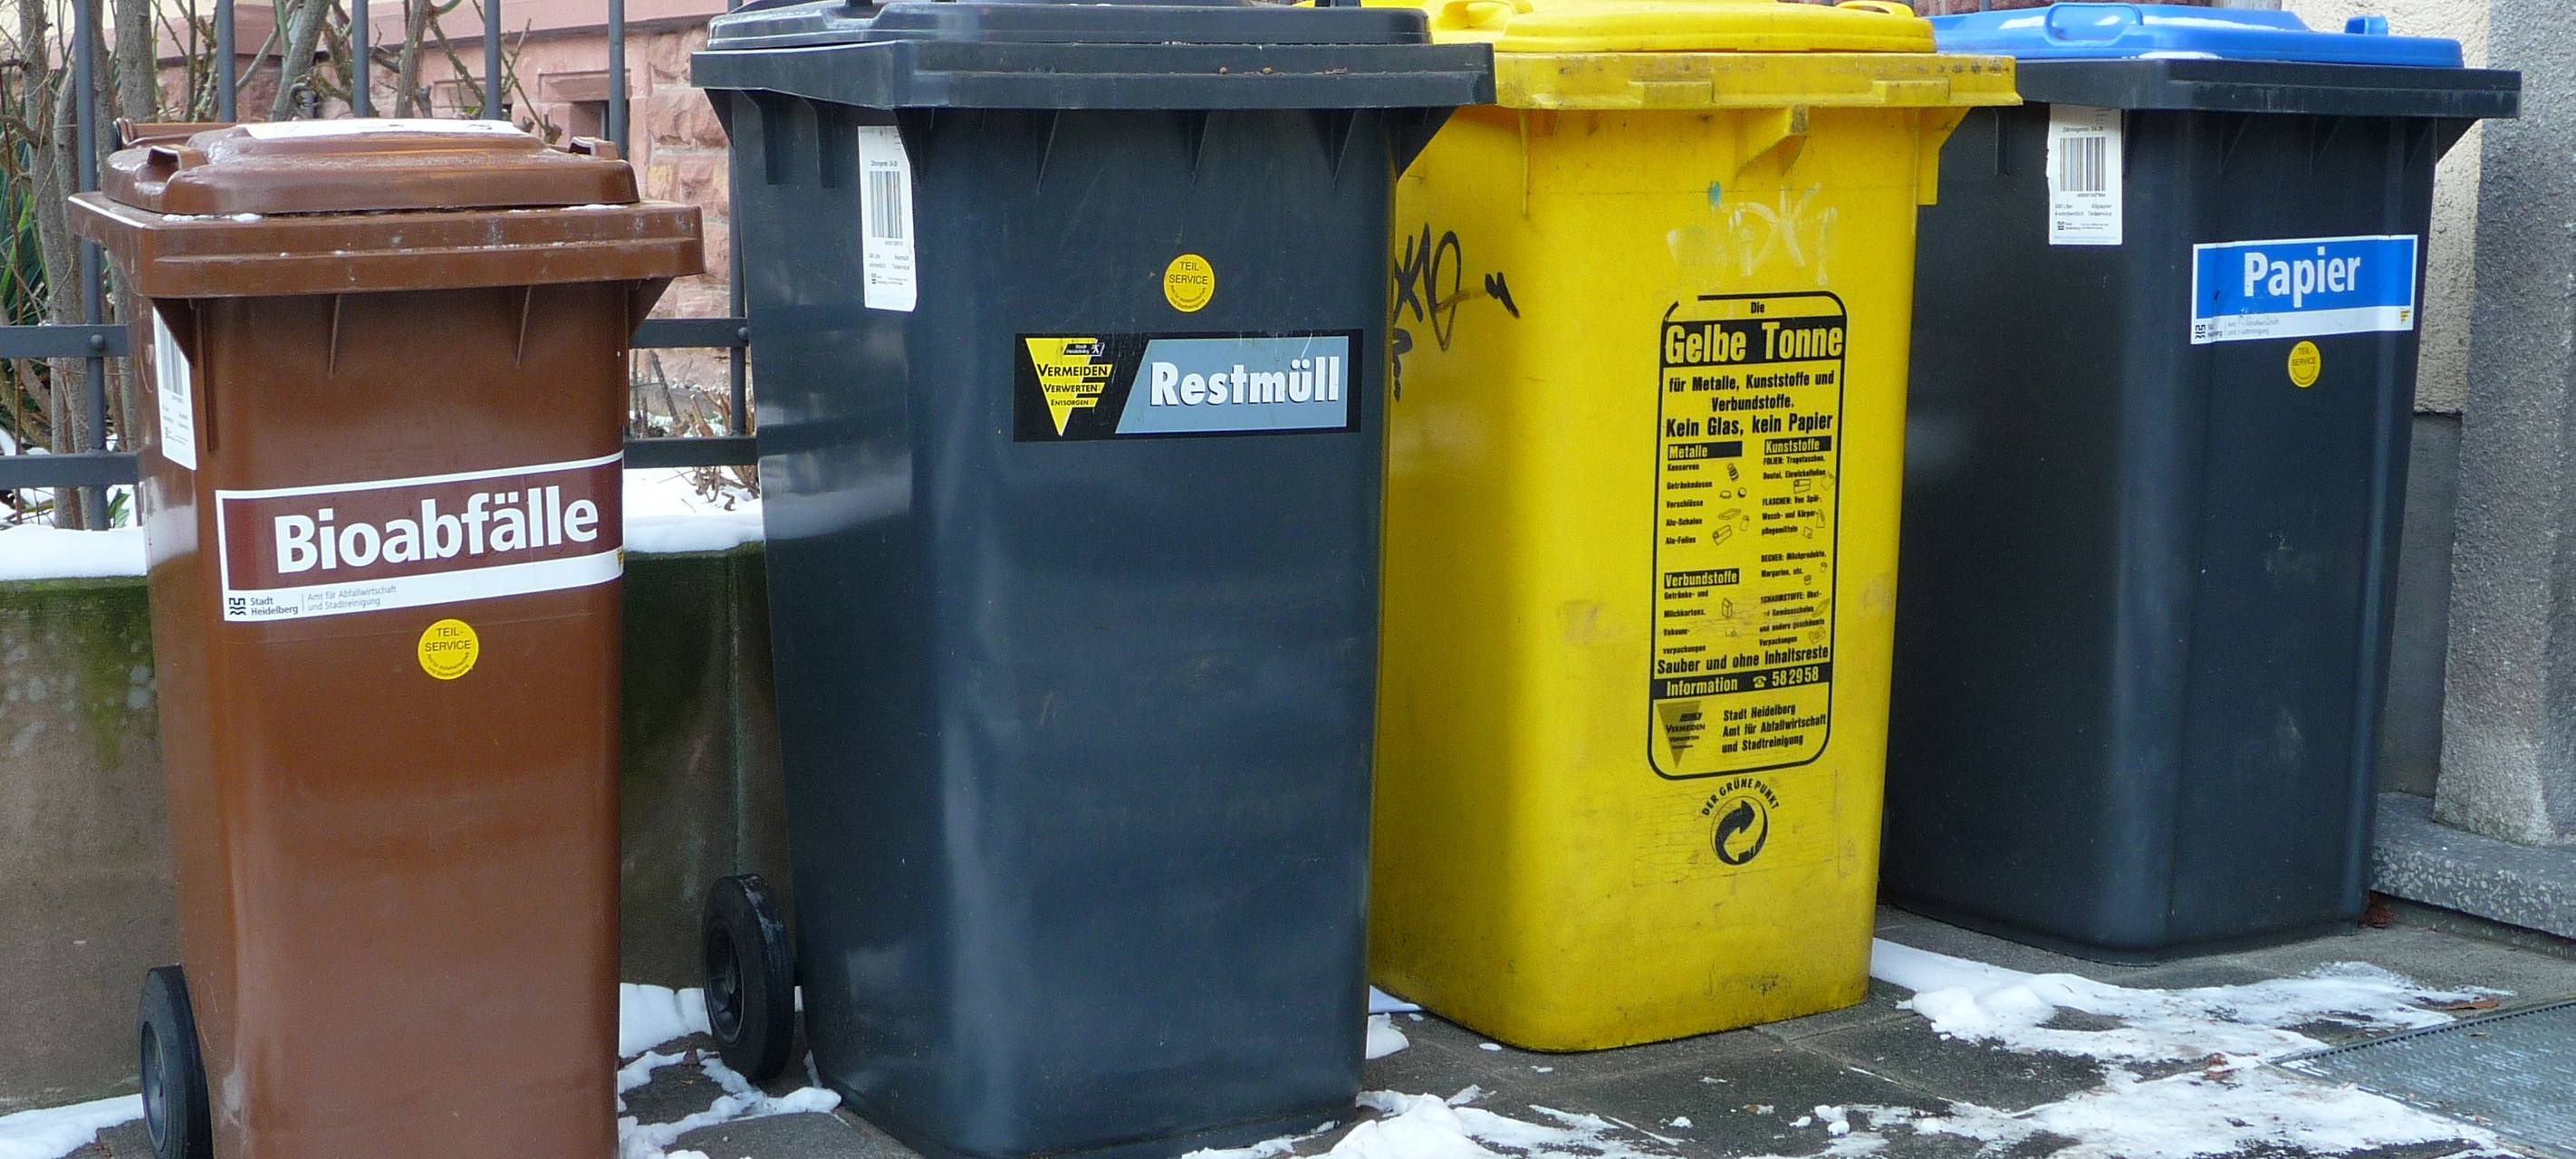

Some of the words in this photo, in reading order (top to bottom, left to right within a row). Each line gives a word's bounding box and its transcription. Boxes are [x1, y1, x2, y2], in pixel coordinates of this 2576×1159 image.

[1179, 261, 1203, 271] TEIL-
[1168, 274, 1208, 285] SERVICE
[2244, 245, 2361, 308] Papier
[1751, 302, 1765, 313] Die
[1665, 323, 1746, 364] Gelbe
[1761, 321, 1842, 360] Tonne
[1037, 363, 1108, 377] VERMEIDEN
[1149, 356, 1340, 407] Restmüll
[1669, 378, 1687, 392] für
[1692, 375, 1739, 391] Metalle,
[1745, 371, 1810, 389] Kunststoffe
[1815, 370, 1834, 385] und
[1043, 384, 1098, 393] VERWERTEN
[1712, 394, 1794, 412] Verbundstoffe.
[1666, 418, 1699, 437] Kein
[1707, 417, 1744, 436] Glas,
[1752, 415, 1782, 434] kein
[1789, 412, 1833, 434] Papier
[1668, 445, 1708, 460] Metalle
[1765, 438, 1821, 454] Kunststoffe
[1667, 464, 1699, 472] Konserven
[1667, 481, 1713, 490] Getränkedosen
[1666, 499, 1703, 509] Verschlüsse
[1785, 510, 1795, 519] und
[1666, 517, 1702, 527] Alu-Schalen
[274, 485, 599, 574] Bioabfälle
[1665, 535, 1697, 545] Alu-Folien
[1666, 570, 1737, 588] Verbundstoffe
[308, 593, 323, 602] Amt
[325, 591, 337, 600] für
[339, 586, 397, 599] Abfallwirtschaft
[1697, 589, 1708, 598] und
[250, 597, 274, 607] Stadt
[308, 602, 322, 611] und
[324, 597, 381, 609] Stadtreinigung
[251, 604, 298, 616] Heidelberg
[436, 627, 464, 637] TEIL-
[425, 639, 471, 652] SERVICE
[1658, 658, 1700, 674] Sauber
[1706, 656, 1726, 670] und
[1733, 653, 1759, 668] ohne
[1764, 646, 1829, 666] Inhaltsreste
[1667, 677, 1738, 697] Information
[1724, 708, 1747, 722] Stadt
[1751, 704, 1796, 719] Heidelberg
[1723, 725, 1740, 738] Amt
[1745, 723, 1756, 735] für
[1760, 714, 1826, 733] Abfallwirtschaft
[1722, 740, 1738, 753] und
[1742, 734, 1803, 752] Stadtreinigung
[1702, 794, 1719, 816] DER
[1719, 777, 1753, 796] GRÜNE
[1754, 781, 1780, 809] PUNKT
